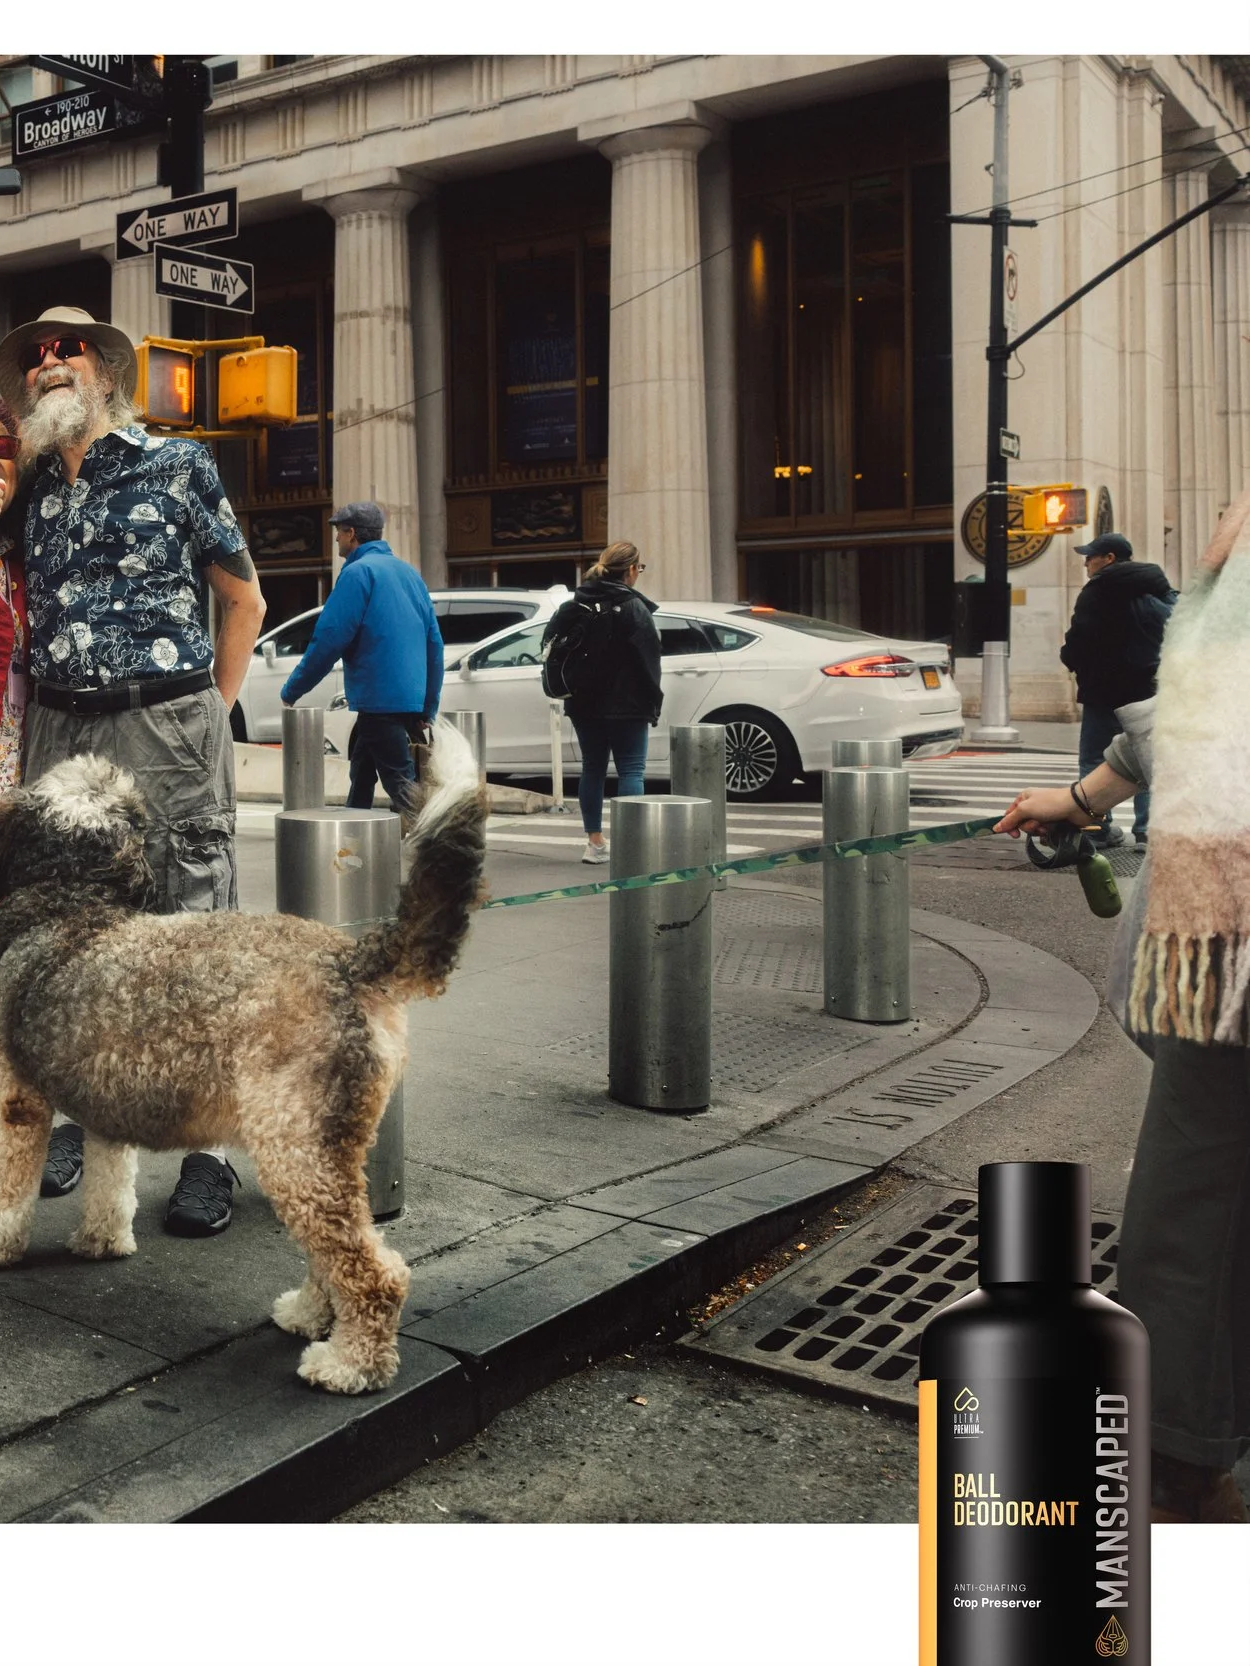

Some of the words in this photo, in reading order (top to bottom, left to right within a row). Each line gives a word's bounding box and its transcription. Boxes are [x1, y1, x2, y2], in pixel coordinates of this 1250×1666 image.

[56, 95, 90, 115] 190-210
[24, 106, 107, 144] Broadway
[33, 135, 59, 149] CANYON
[62, 132, 70, 142] OF
[73, 125, 98, 138] HEROES
[134, 218, 166, 242] ONE
[183, 206, 220, 231] WAY
[170, 264, 198, 287] ONE
[211, 272, 239, 295] WAY
[871, 1058, 1005, 1108] FULTON
[953, 1413, 980, 1424] ULTRA
[954, 1473, 1001, 1498] BALL
[954, 1501, 1079, 1526] DEODORANT
[953, 1583, 1027, 1593] ANTI-CHAFING
[953, 1596, 978, 1610] Crop
[981, 1597, 1042, 1608] Preserver
